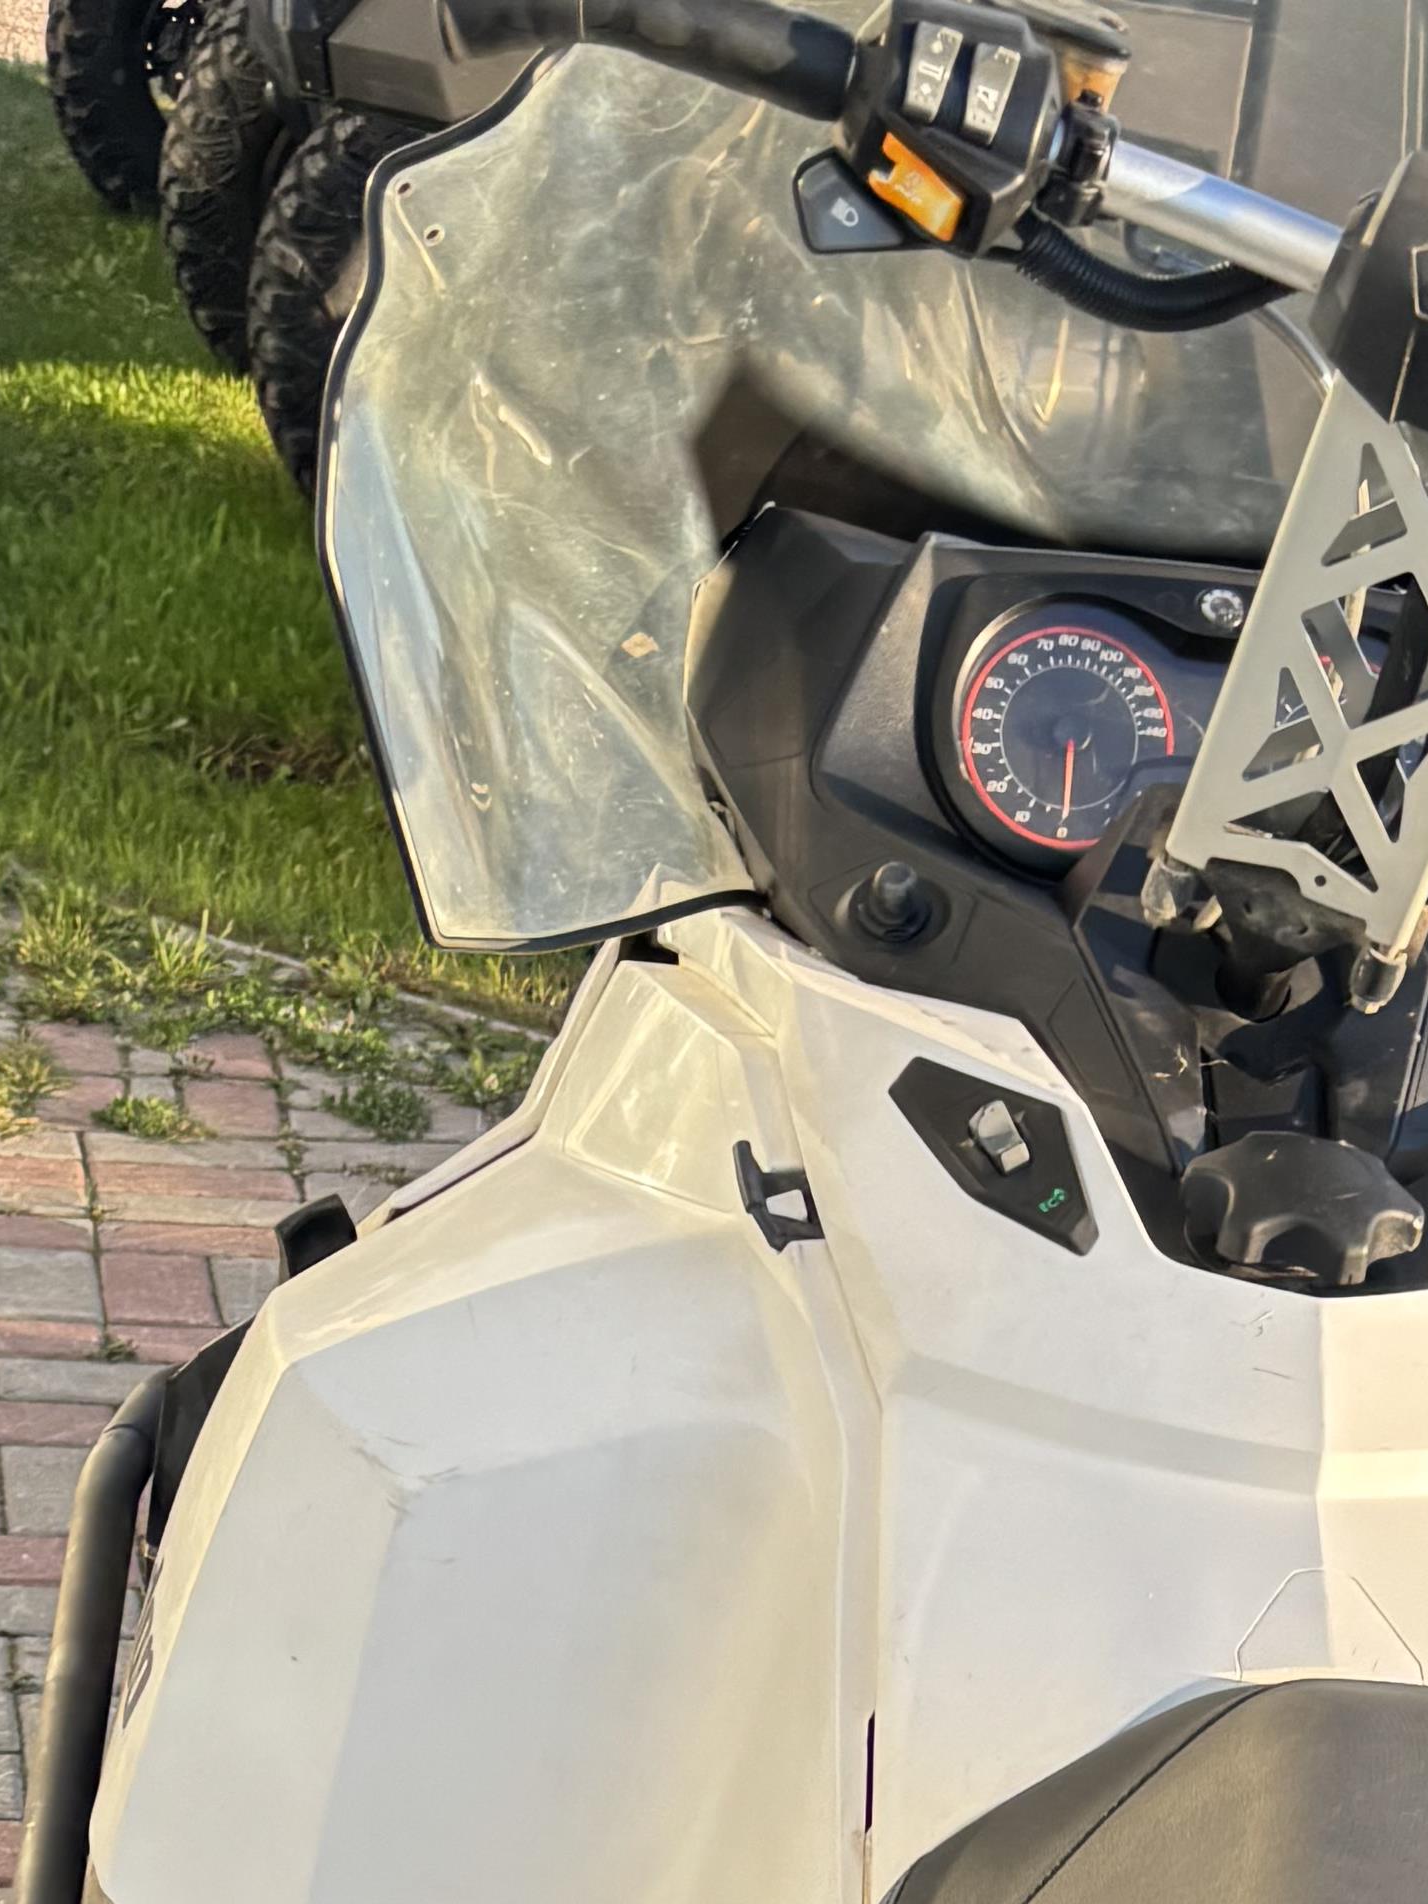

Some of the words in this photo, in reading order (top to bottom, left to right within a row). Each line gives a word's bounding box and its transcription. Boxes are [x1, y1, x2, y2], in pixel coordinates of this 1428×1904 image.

[1036, 639, 1054, 651] 70
[1099, 650, 1124, 662] 100
[972, 708, 993, 720] 40
[971, 742, 992, 755] 30
[986, 780, 1008, 793] 20
[1014, 810, 1030, 823] 10
[1056, 826, 1068, 838] 0
